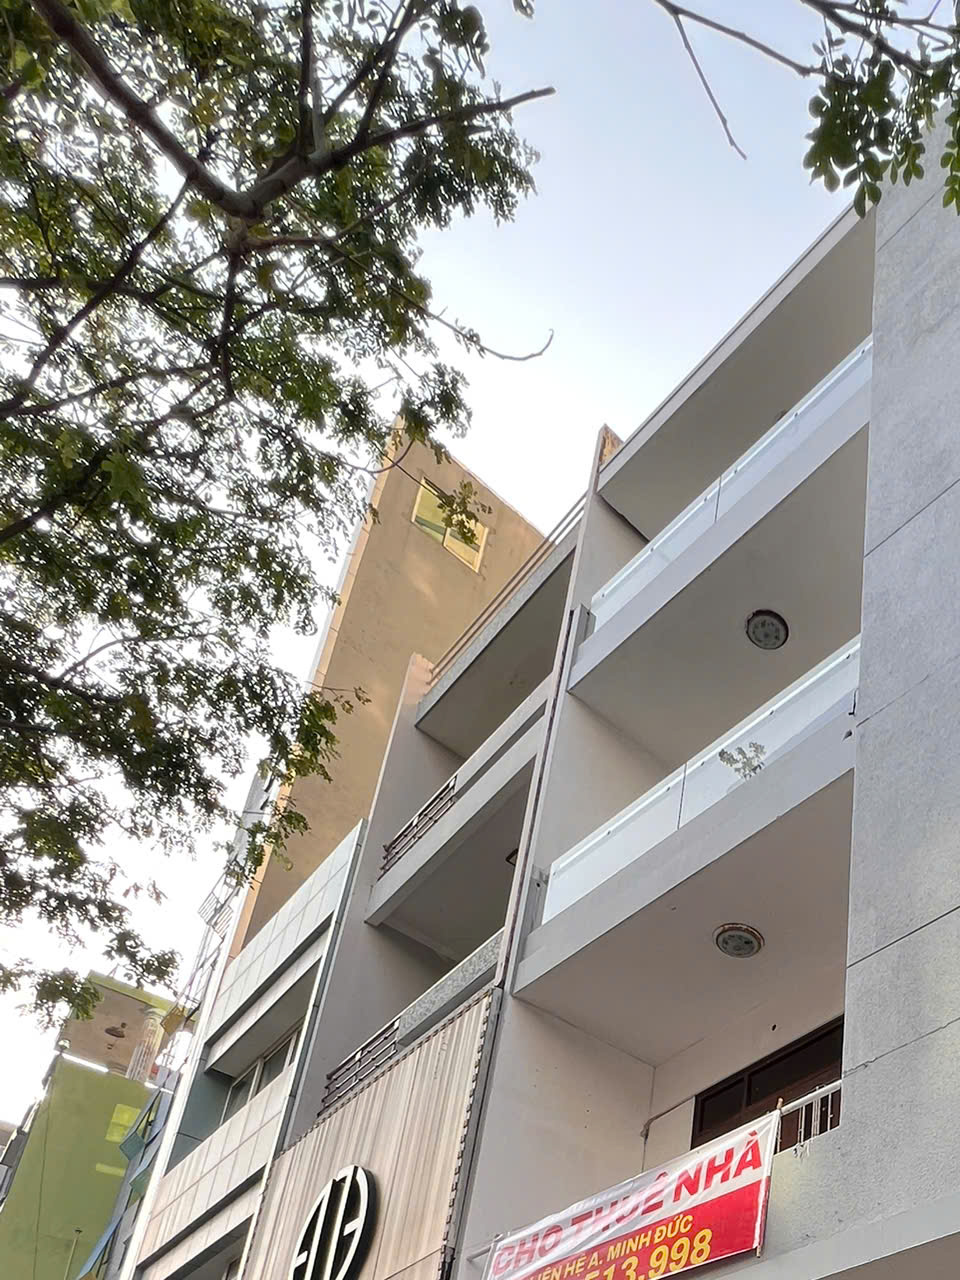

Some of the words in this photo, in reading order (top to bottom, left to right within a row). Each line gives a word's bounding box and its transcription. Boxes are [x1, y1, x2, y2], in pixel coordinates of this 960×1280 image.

[493, 1224, 563, 1276] CHO
[673, 1130, 762, 1202] NHÀ
[564, 1253, 586, 1280] HỆ
[587, 1255, 603, 1270] A.
[606, 1231, 650, 1263] MINH
[654, 1213, 694, 1243] ĐỨC
